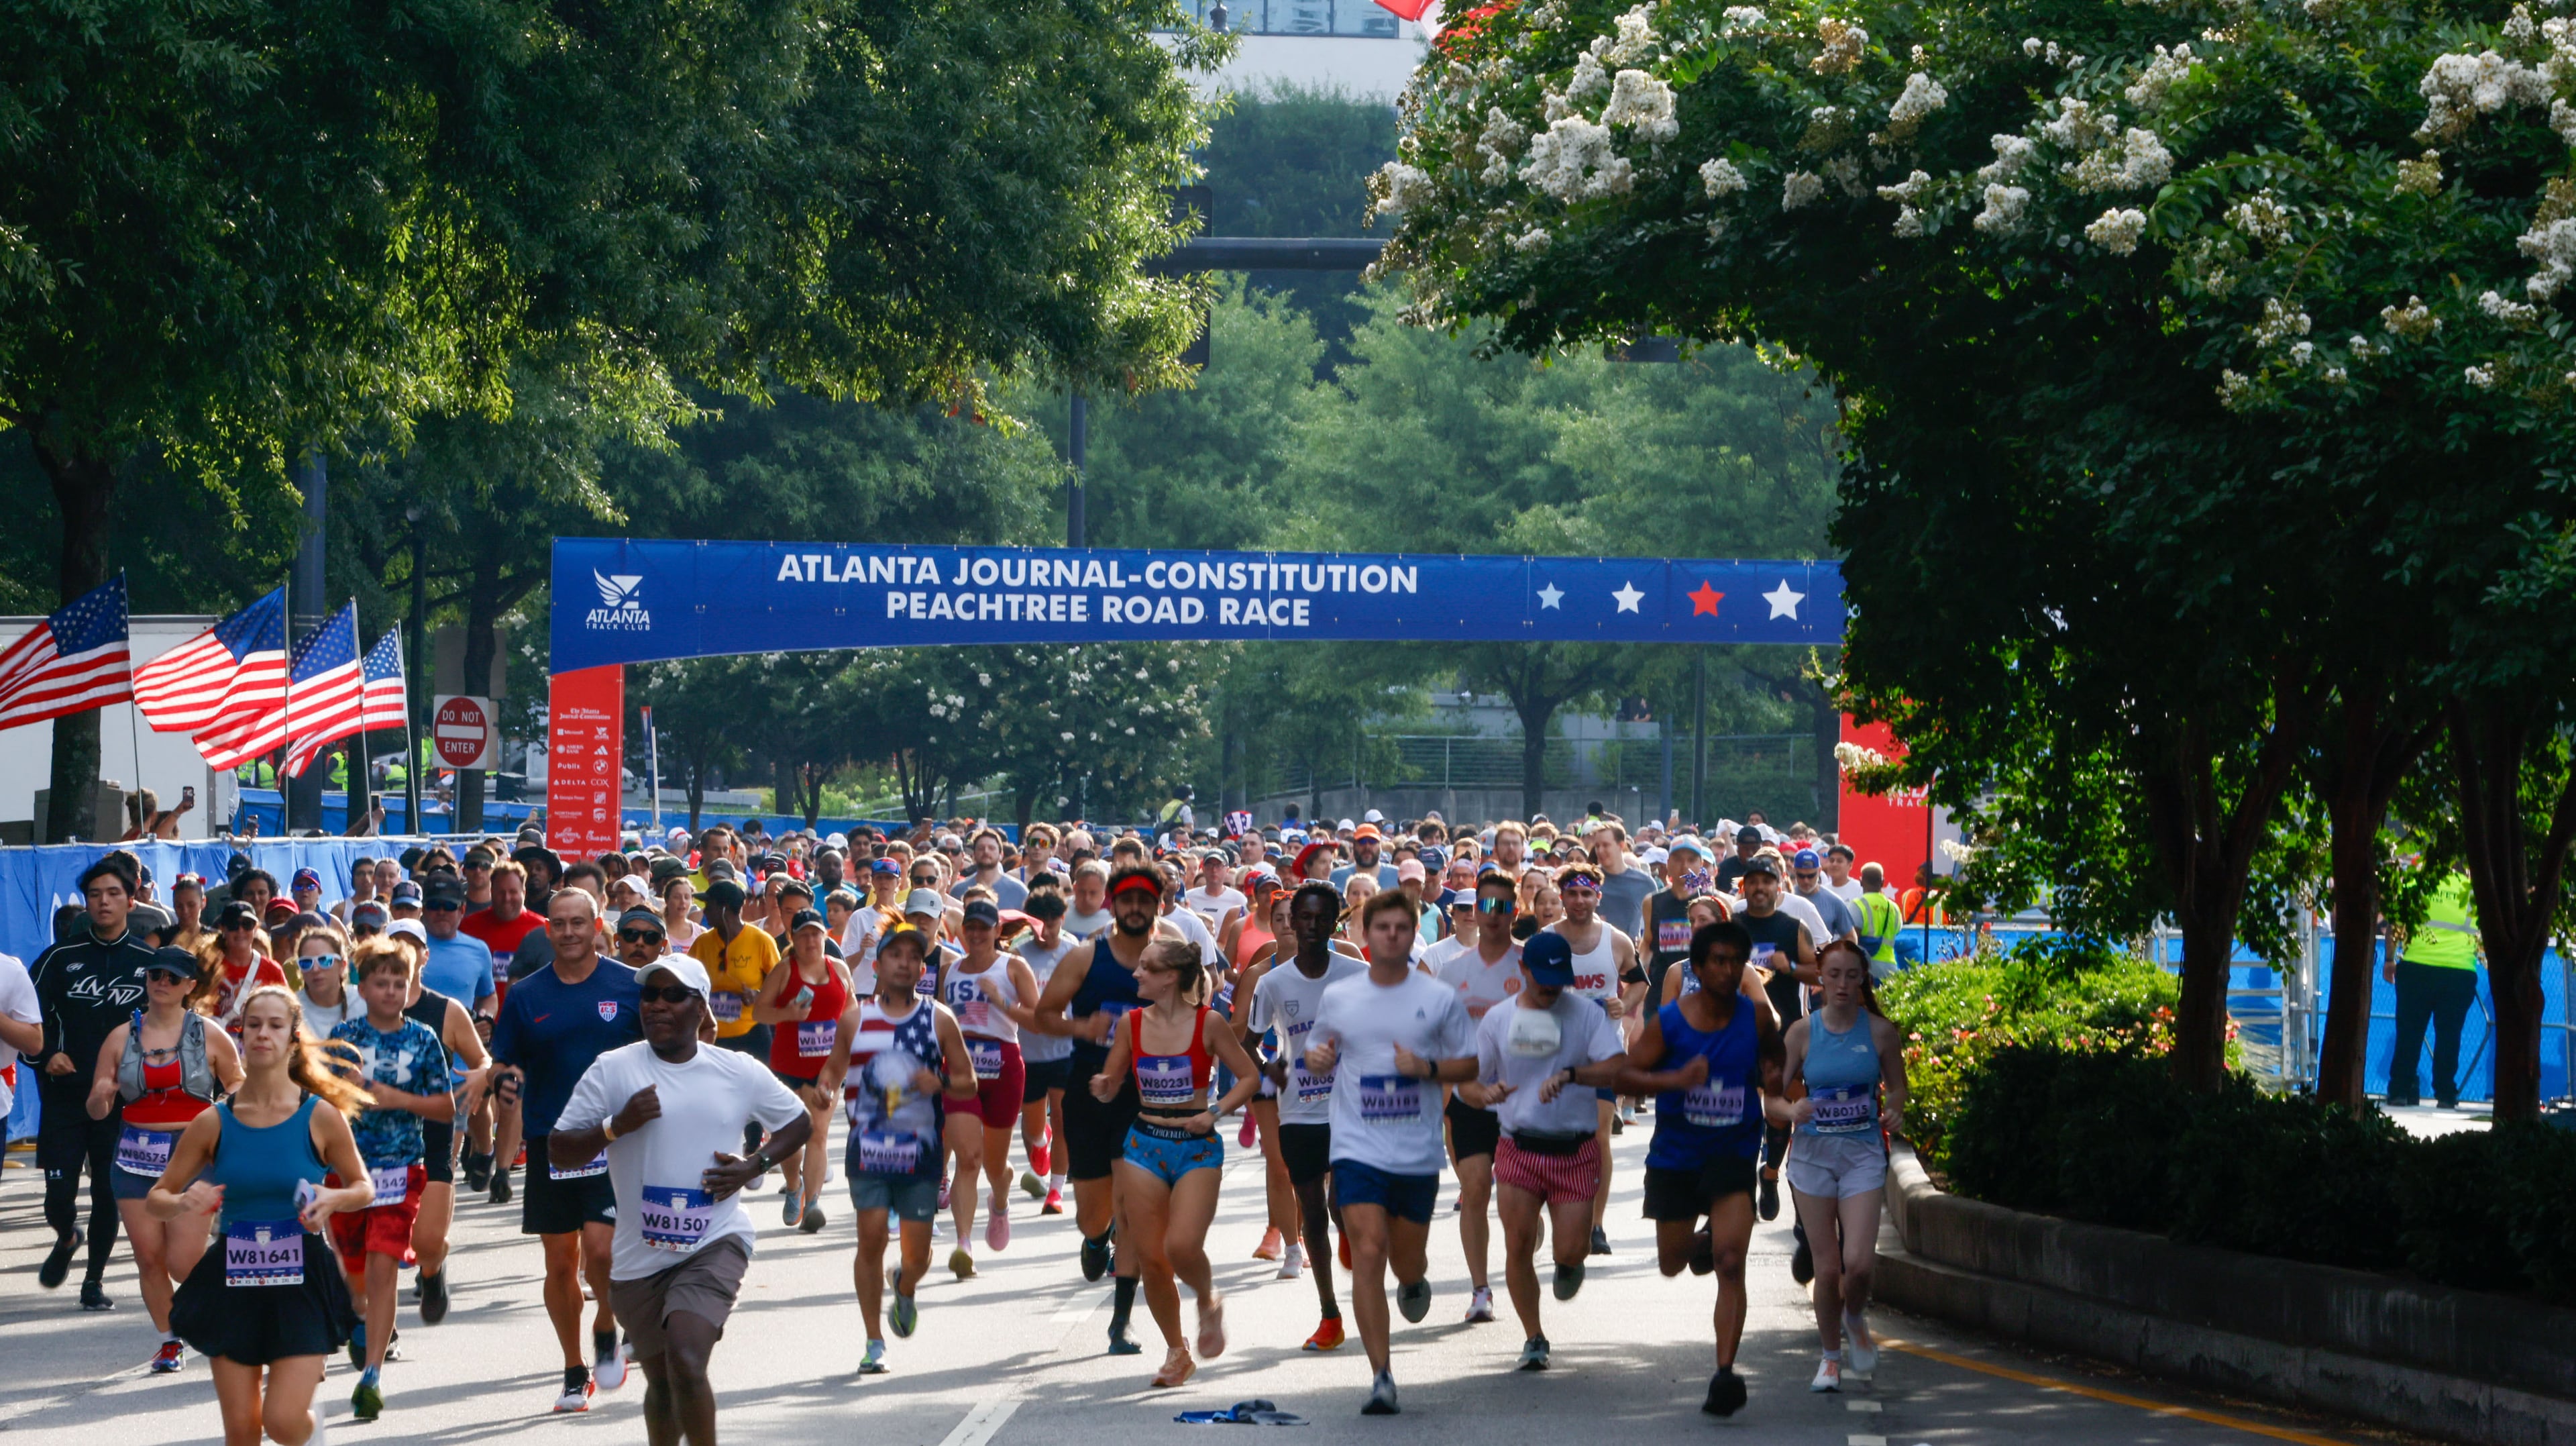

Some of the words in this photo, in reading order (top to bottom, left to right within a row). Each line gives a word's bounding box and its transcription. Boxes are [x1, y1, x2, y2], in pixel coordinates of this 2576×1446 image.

[777, 554, 941, 584] ATLANTA
[953, 558, 1417, 594] JOURNAL-CONSTITUTION
[888, 591, 1087, 622] PEACHTREE
[1103, 595, 1204, 624] ROAD
[1220, 598, 1309, 626] RACE
[586, 609, 650, 624] ATLANTA
[442, 710, 455, 721] DO
[462, 711, 480, 723] NOT
[445, 741, 475, 754] ENTER
[591, 778, 610, 788] COX
[1888, 798, 1921, 807] TRAC
[799, 1035, 833, 1046] W8164
[1140, 1077, 1189, 1088] W80231
[1298, 1074, 1334, 1087] W806
[120, 1148, 167, 1164] W80575
[374, 1176, 407, 1190] 1542
[228, 1248, 299, 1264] W81641
